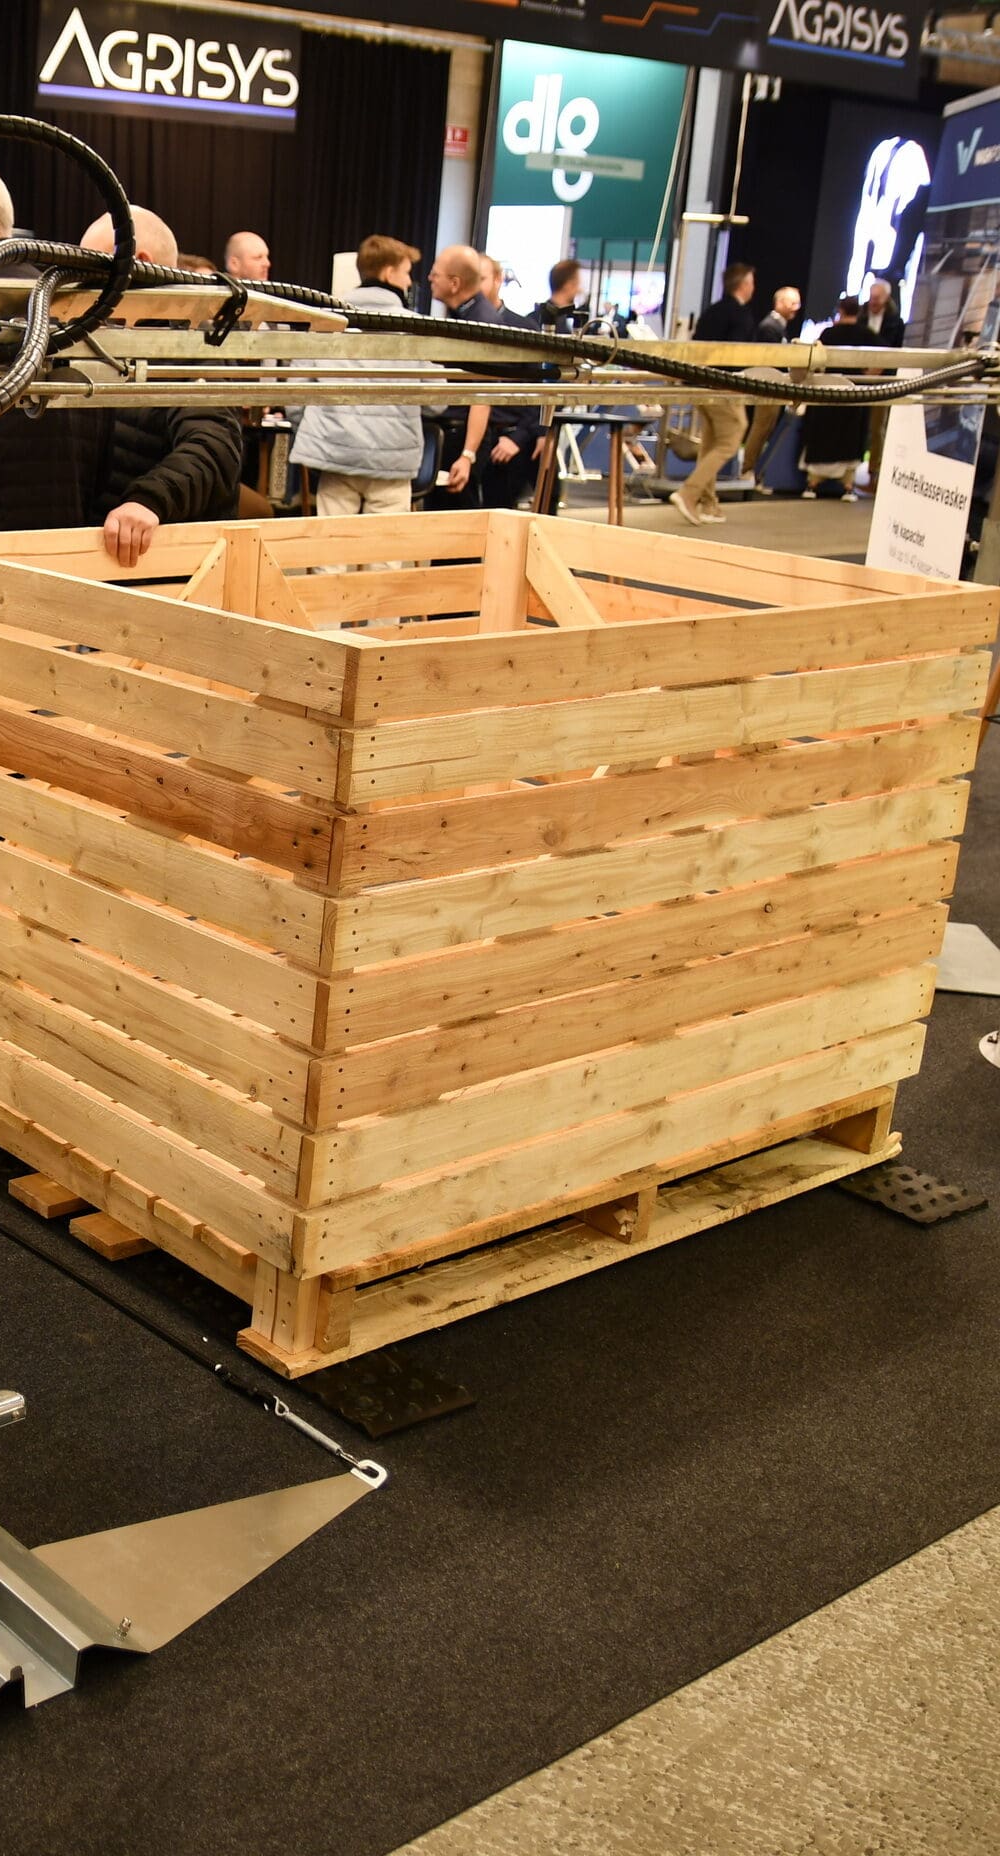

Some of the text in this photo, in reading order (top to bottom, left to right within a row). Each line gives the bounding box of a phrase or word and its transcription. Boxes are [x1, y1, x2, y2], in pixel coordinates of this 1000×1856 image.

[39, 7, 299, 107] AGRISYS
[768, 0, 908, 58] AGRISYS
[502, 73, 599, 202] dlg
